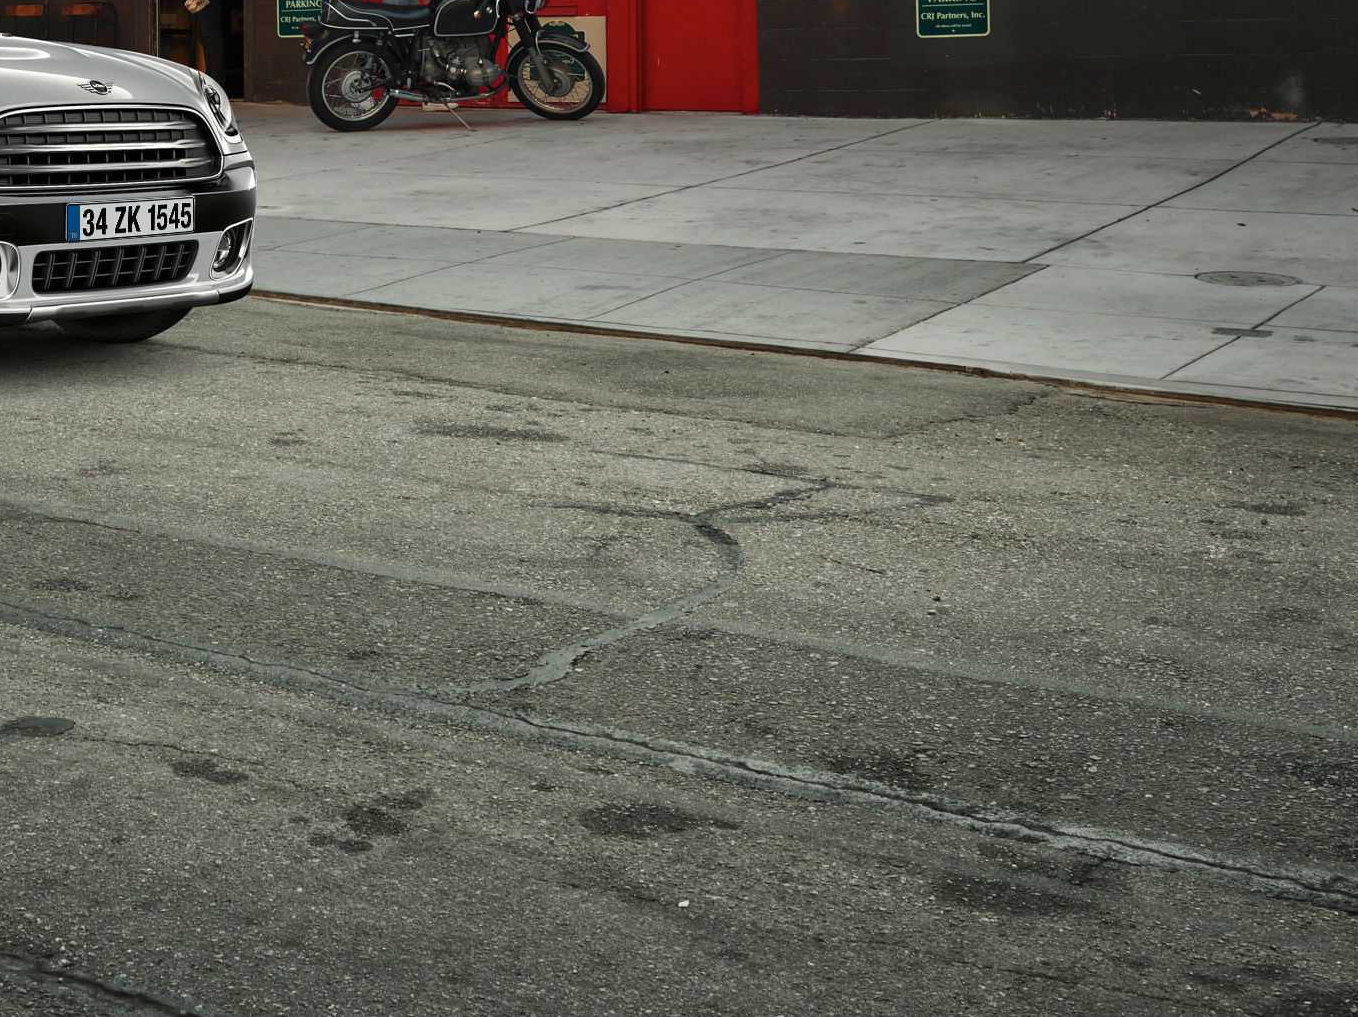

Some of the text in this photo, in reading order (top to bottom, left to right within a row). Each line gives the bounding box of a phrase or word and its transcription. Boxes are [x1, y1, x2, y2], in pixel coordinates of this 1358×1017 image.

[920, 10, 986, 21] CRJ Partners, Inc.
[82, 202, 192, 237] 34 ZK 1545
